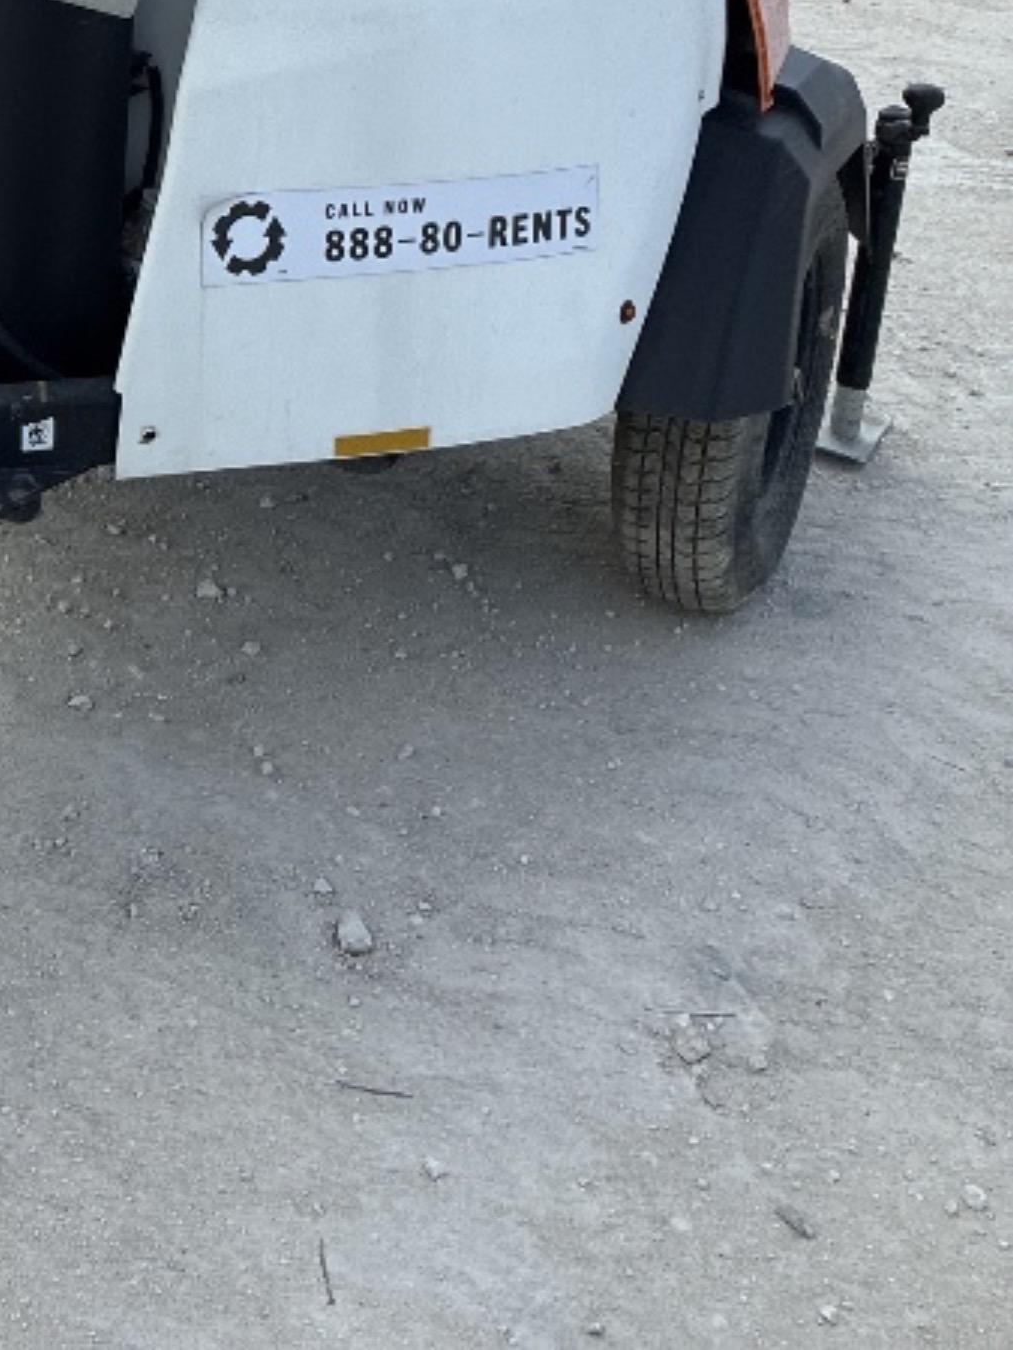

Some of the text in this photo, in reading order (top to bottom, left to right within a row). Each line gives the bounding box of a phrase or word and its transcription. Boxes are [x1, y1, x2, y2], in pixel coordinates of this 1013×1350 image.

[325, 197, 426, 220] CALL NOW
[324, 206, 592, 262] 888-80-RENTS
